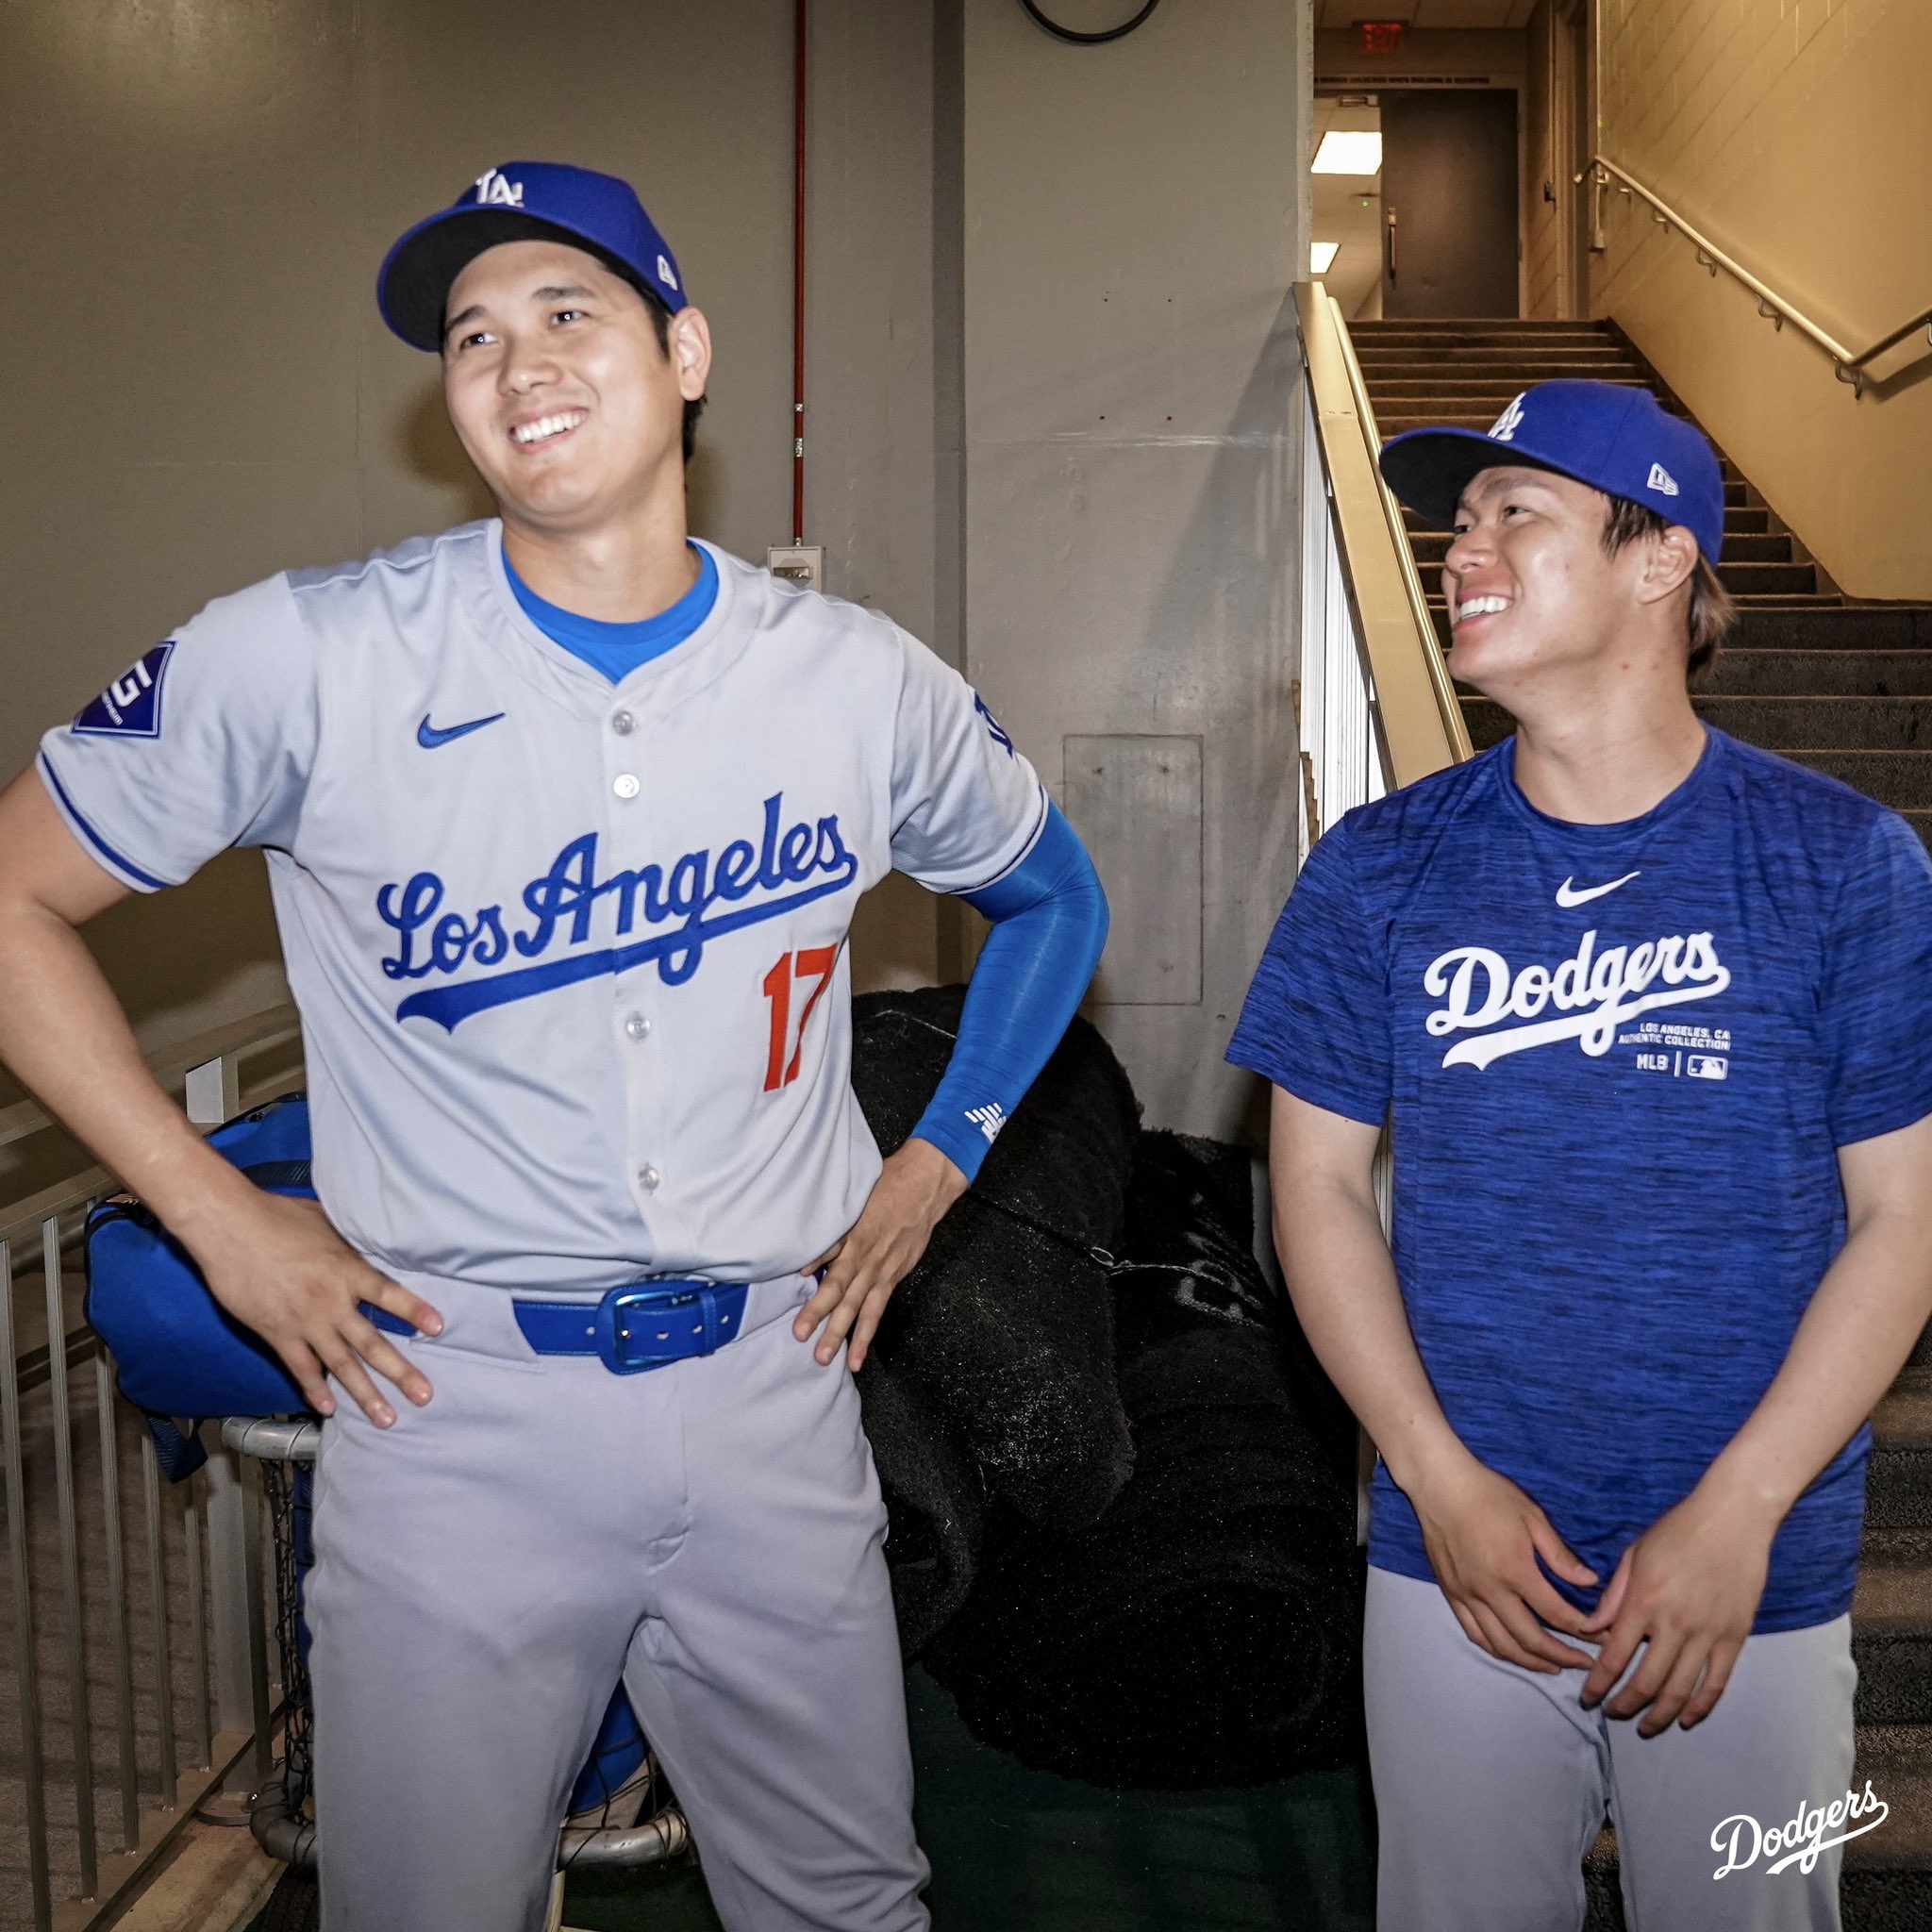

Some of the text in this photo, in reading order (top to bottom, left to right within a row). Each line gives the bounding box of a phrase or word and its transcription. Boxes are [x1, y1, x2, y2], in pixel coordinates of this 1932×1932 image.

[377, 791, 858, 987] Los Angeles
[762, 942, 840, 1092] 17
[1424, 929, 1731, 1066] Dodgers
[1640, 1023, 1659, 1033] LOS
[1714, 1029, 1731, 1041] CA
[1618, 1033, 1731, 1051] AUTHENTIC COLLECTION
[1637, 1054, 1669, 1071] MLB
